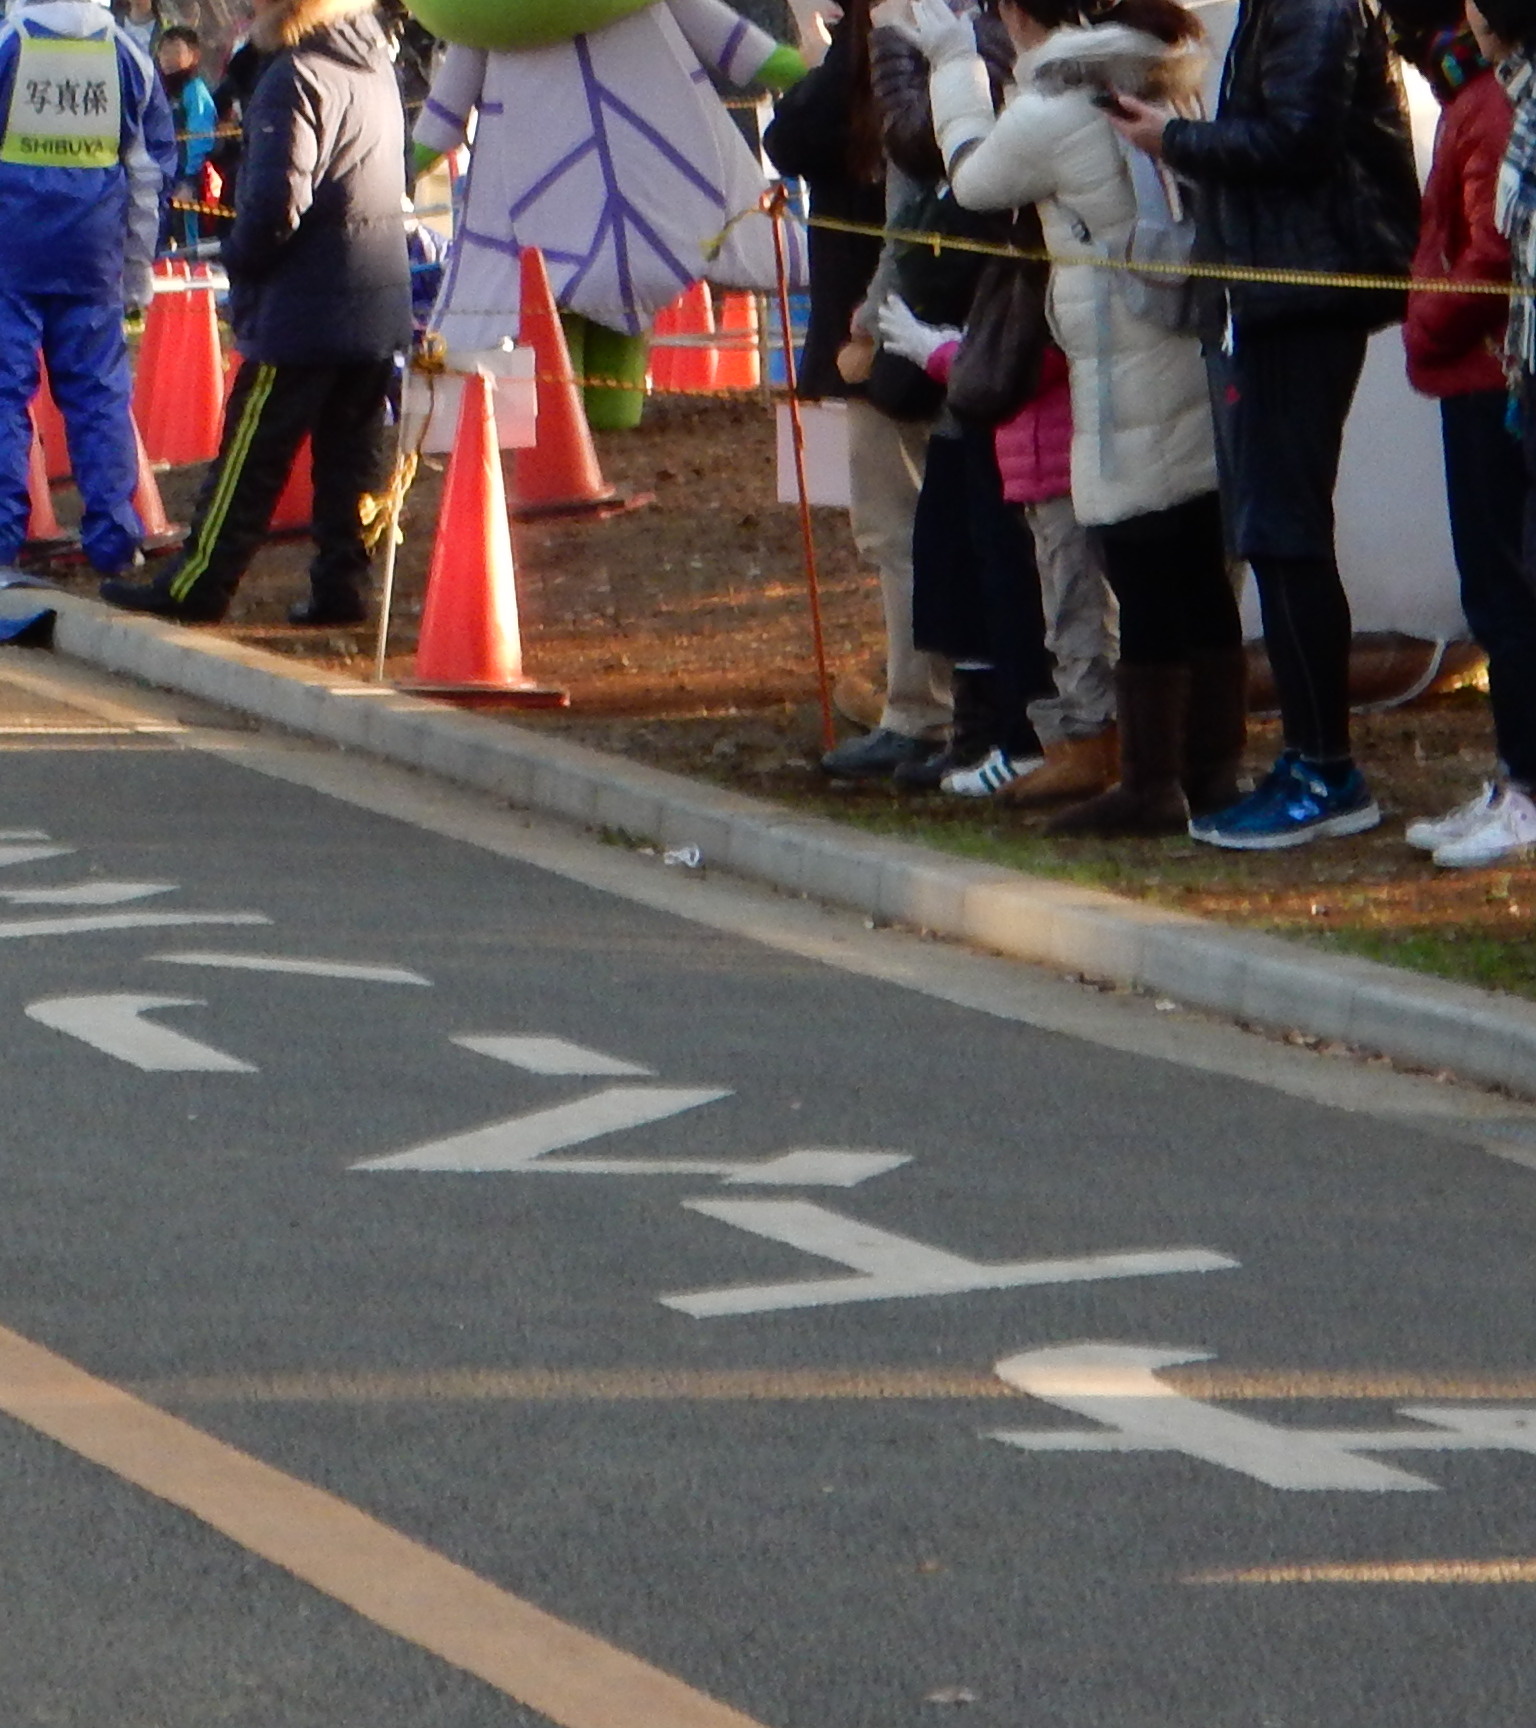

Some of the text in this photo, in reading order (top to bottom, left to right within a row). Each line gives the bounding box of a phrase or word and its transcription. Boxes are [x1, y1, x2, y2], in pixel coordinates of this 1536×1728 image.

[25, 78, 108, 117] 写真係
[19, 137, 105, 157] SHIBUYA
